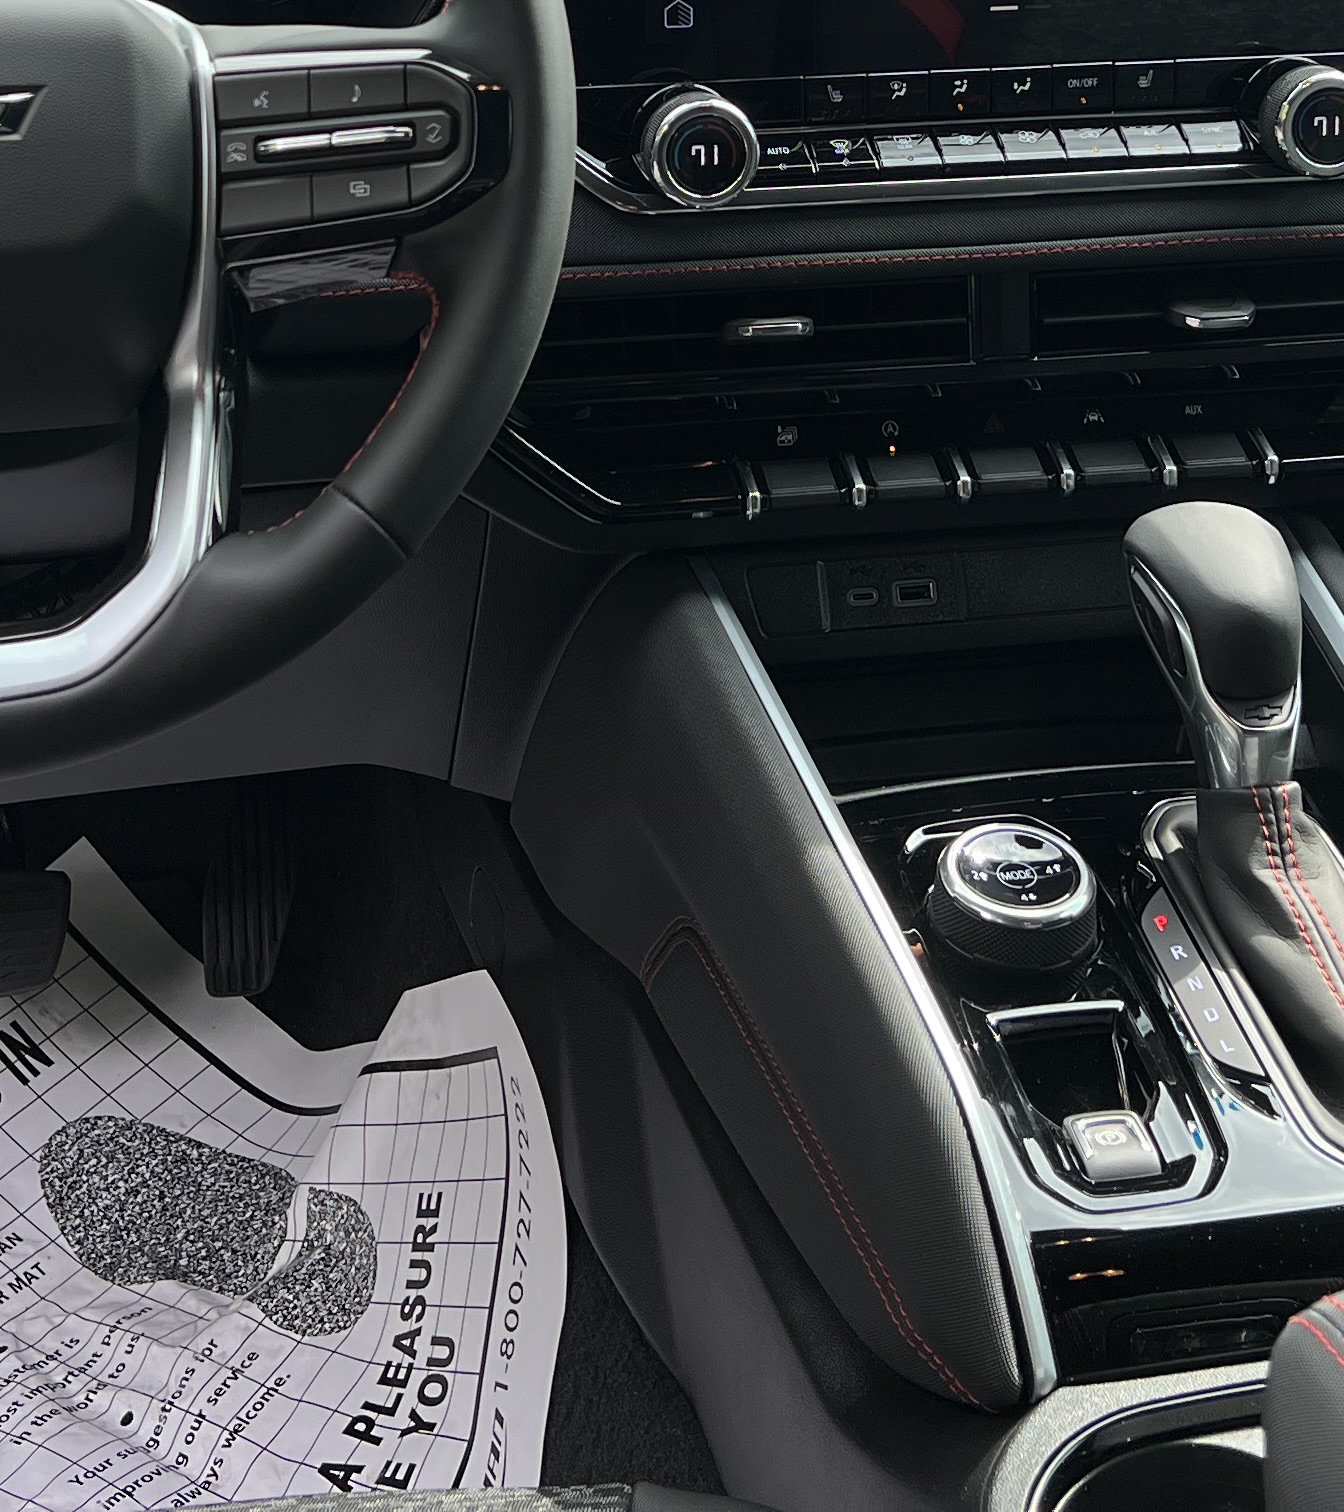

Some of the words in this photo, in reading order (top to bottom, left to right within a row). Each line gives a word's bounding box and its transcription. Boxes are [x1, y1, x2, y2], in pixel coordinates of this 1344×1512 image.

[1067, 77, 1099, 89] ON/OFF
[1313, 116, 1341, 137] 71
[690, 144, 719, 167] 71
[766, 145, 790, 156] AUTO
[1184, 404, 1203, 416] AUX
[999, 869, 1035, 881] MODE
[1153, 914, 1169, 932] P
[1169, 944, 1188, 960] R
[1186, 975, 1204, 992] N
[1203, 1007, 1220, 1023] D
[1219, 1039, 1235, 1053] L
[492, 1074, 535, 1393] 1-800-727-7222
[6, 1261, 48, 1294] MAT
[59, 1336, 81, 1352] is
[316, 1460, 366, 1493] A
[342, 1190, 444, 1448] PLEASURE
[19, 1350, 104, 1402] important
[101, 1305, 154, 1347] person
[397, 1335, 457, 1441] YOU
[9, 1426, 32, 1447] in
[30, 1404, 63, 1428] the
[61, 1378, 109, 1415] world
[107, 1360, 128, 1381] to
[66, 1456, 115, 1488] Your
[192, 1337, 220, 1363] for
[96, 1451, 190, 1511] improving
[183, 1408, 209, 1447] our
[205, 1349, 262, 1408] service
[169, 1455, 225, 1509] always
[220, 1372, 293, 1451] welcome.
